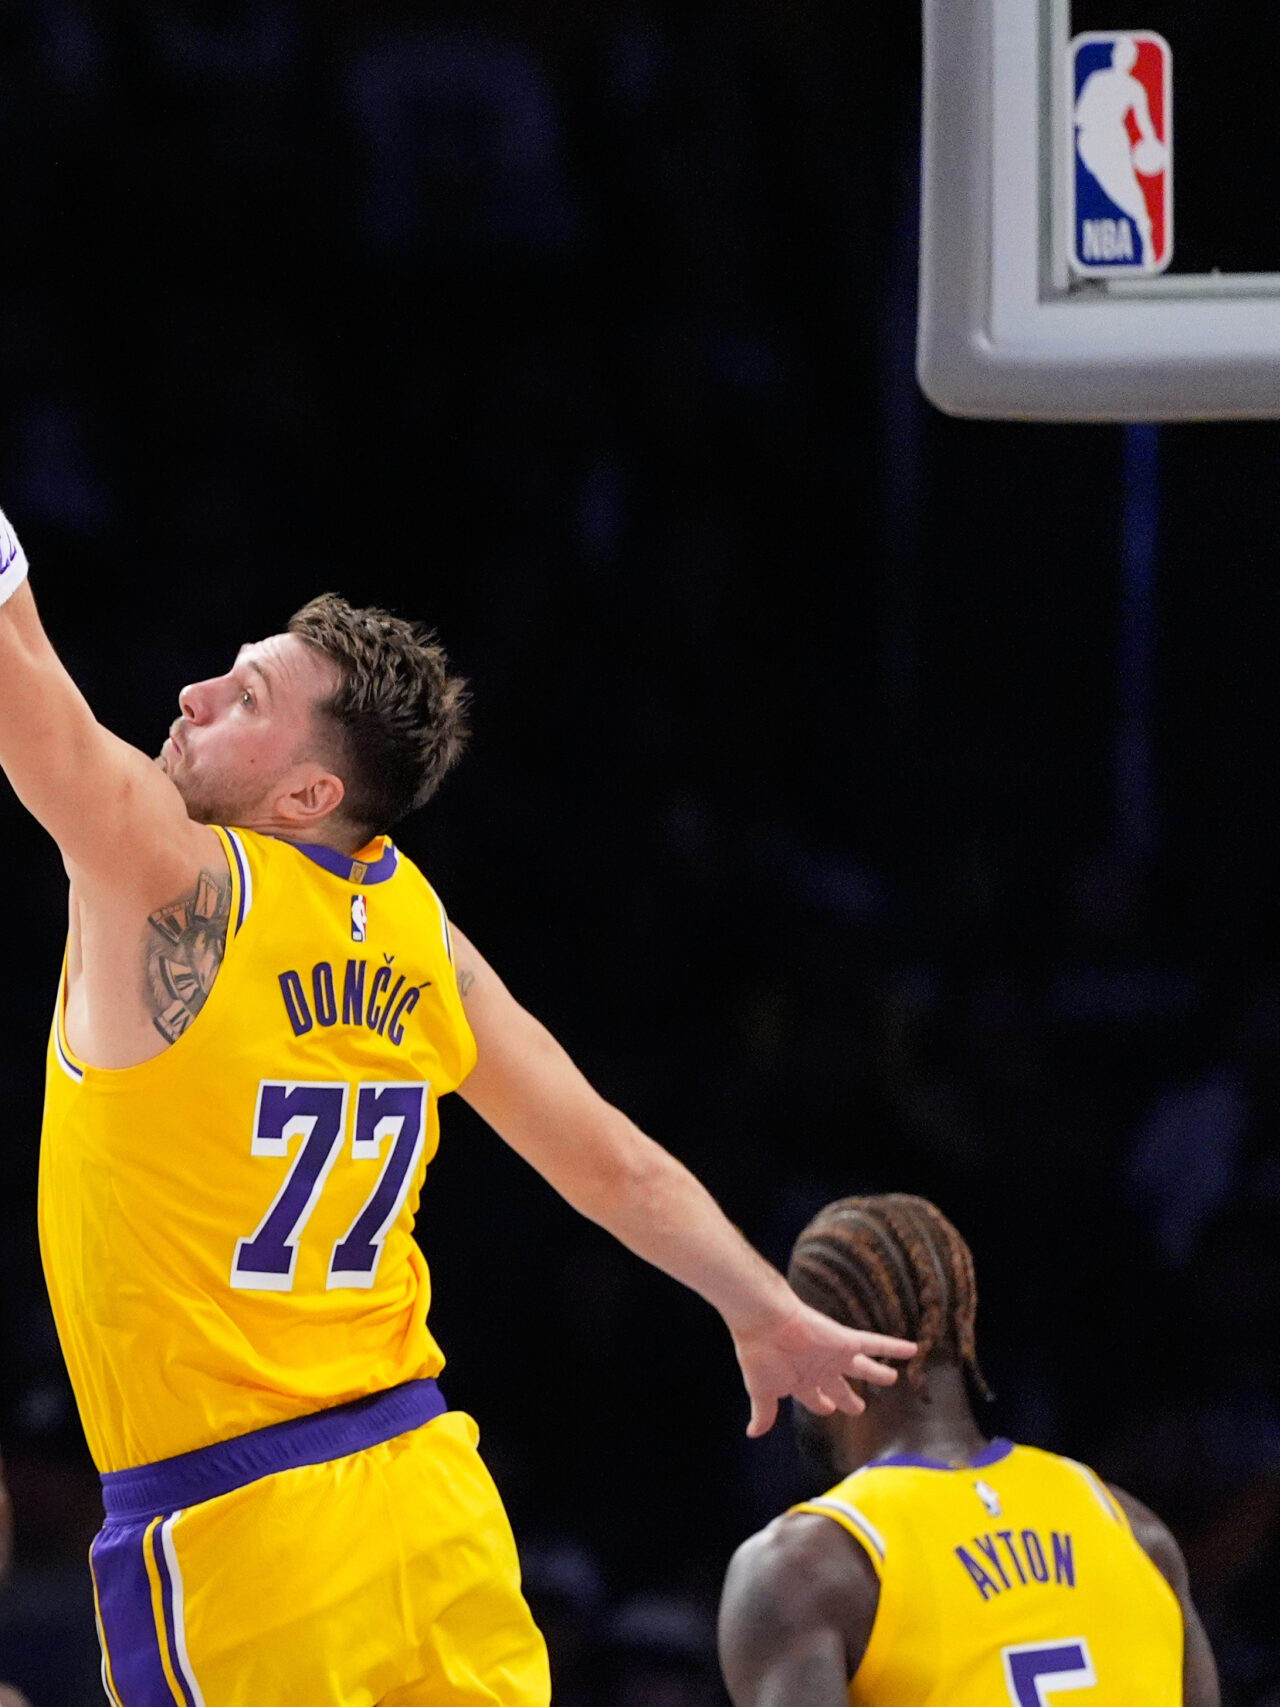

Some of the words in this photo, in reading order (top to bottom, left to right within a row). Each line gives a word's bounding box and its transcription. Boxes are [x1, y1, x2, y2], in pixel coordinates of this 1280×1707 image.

[1082, 218, 1134, 261] NBA
[277, 952, 432, 1047] DONČIĆ
[229, 1079, 430, 1292] 77
[954, 1529, 1076, 1602] AYTON
